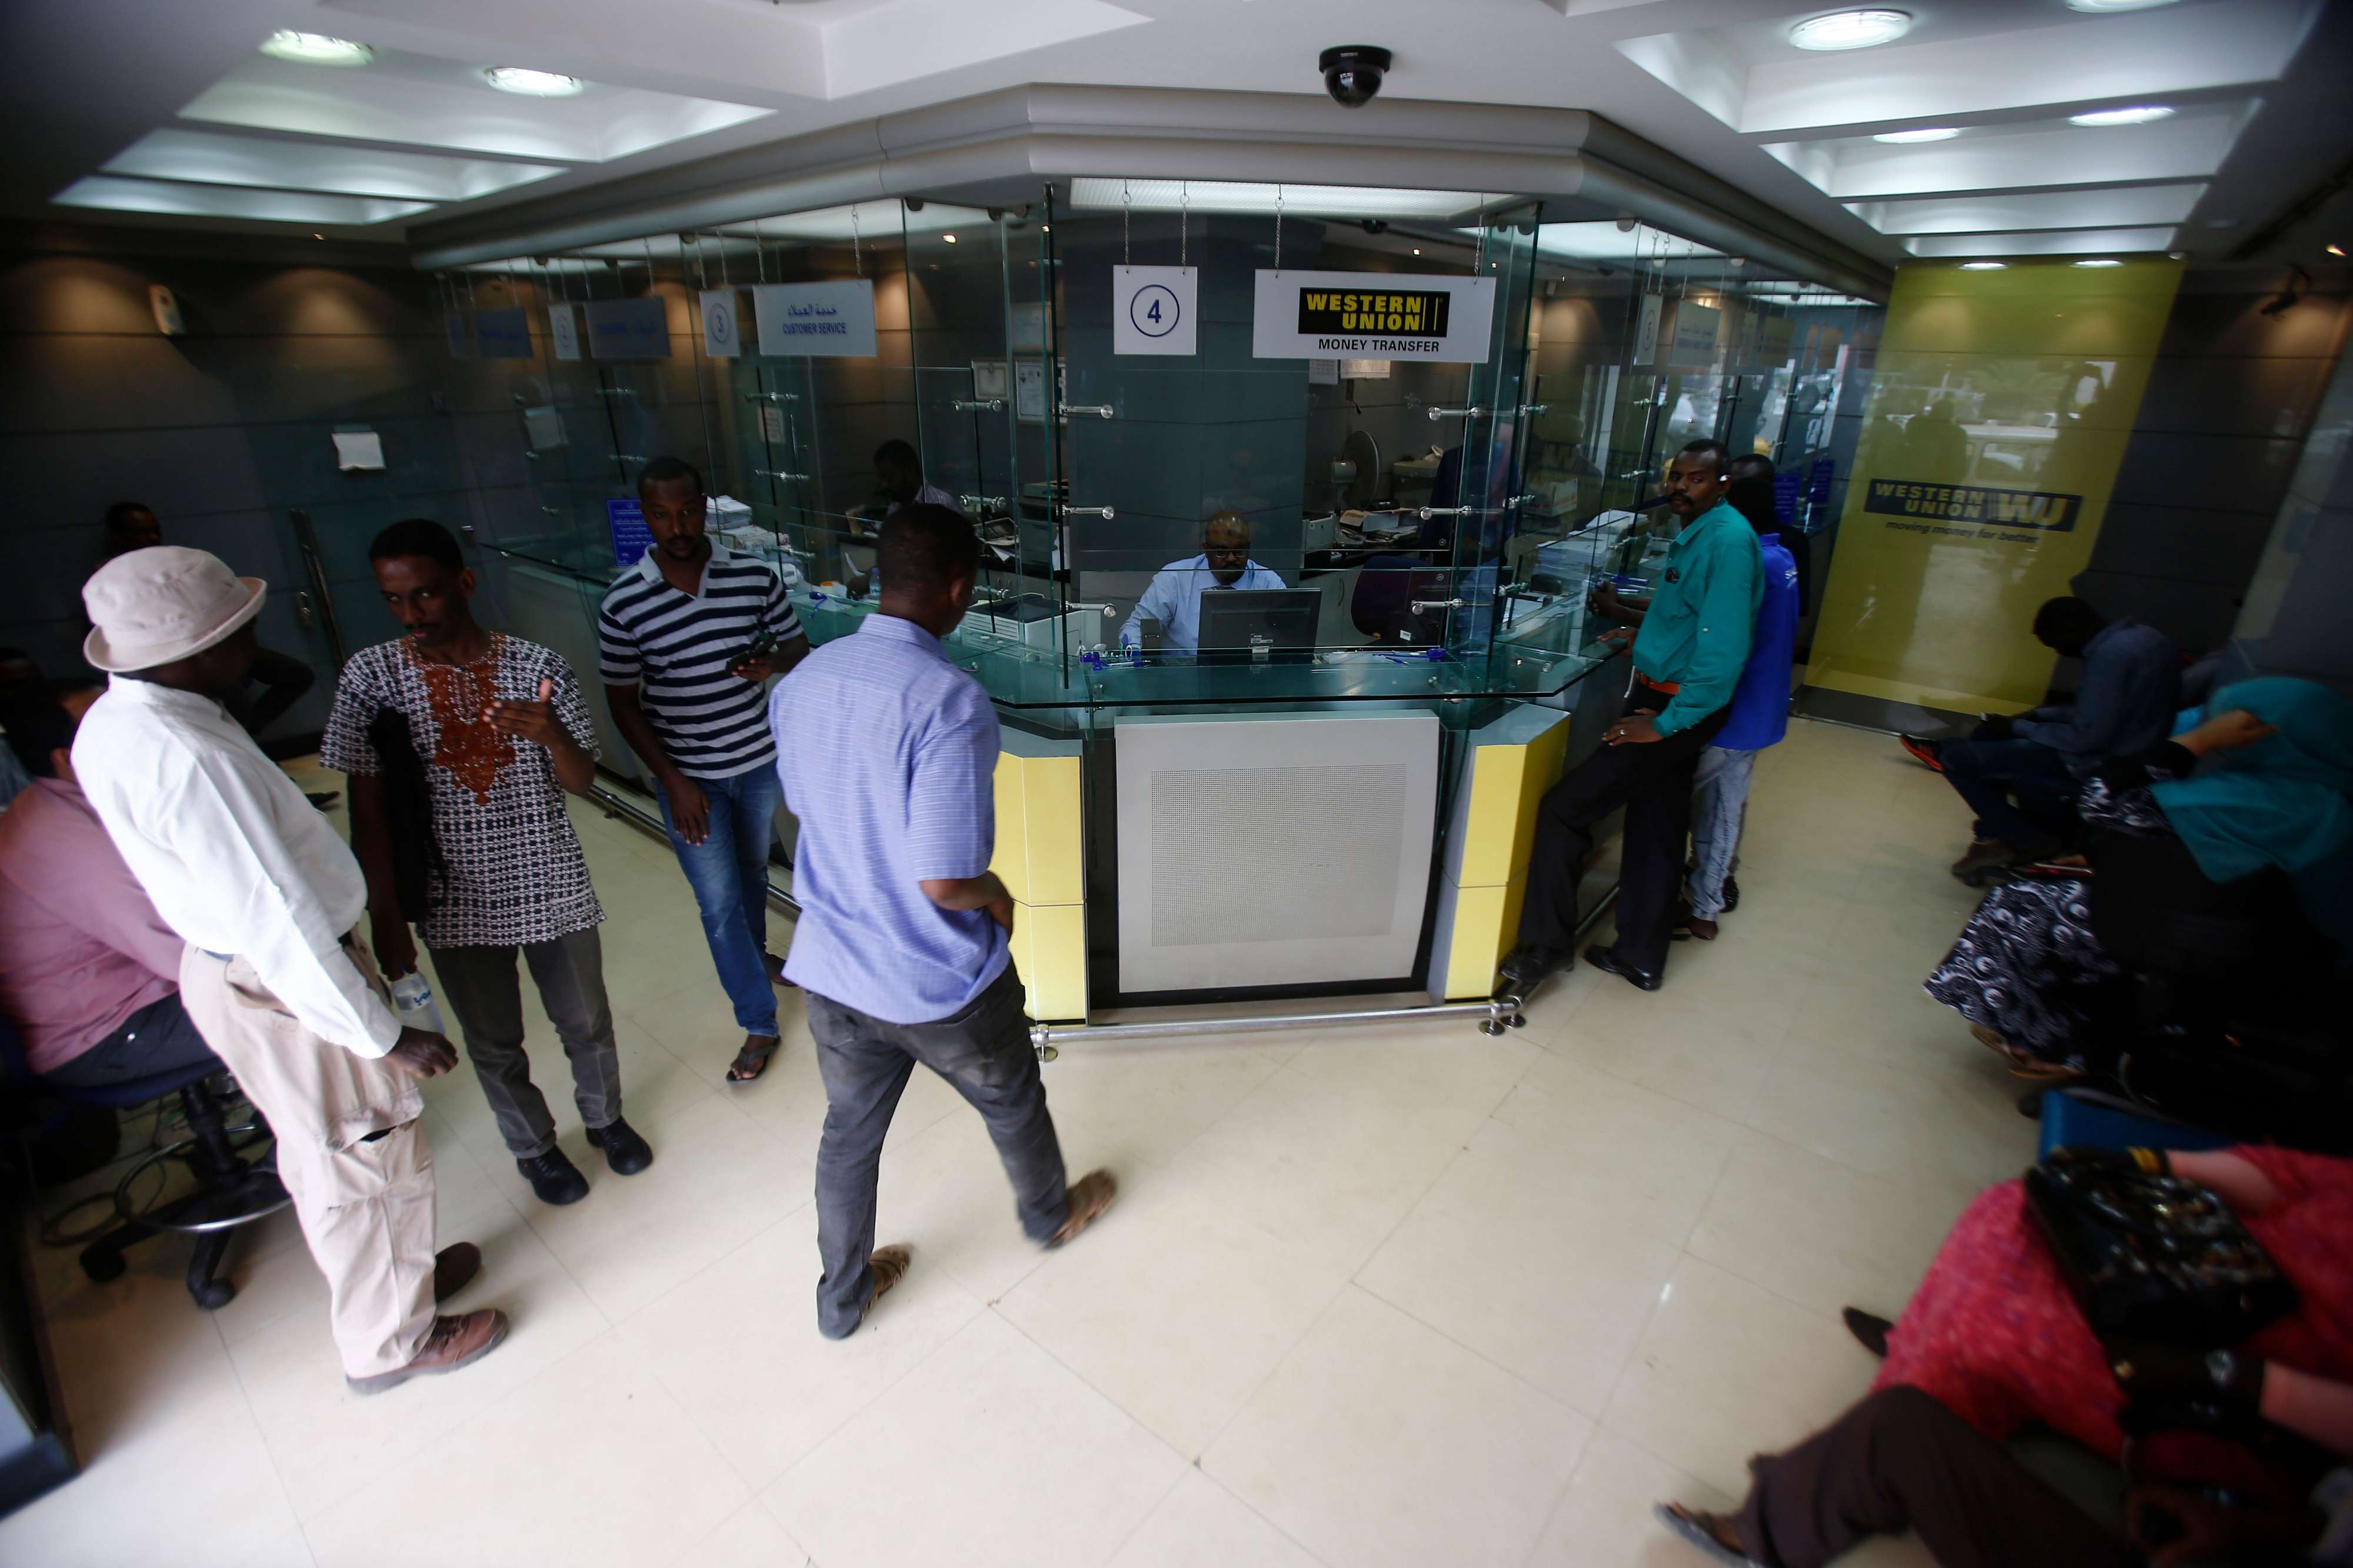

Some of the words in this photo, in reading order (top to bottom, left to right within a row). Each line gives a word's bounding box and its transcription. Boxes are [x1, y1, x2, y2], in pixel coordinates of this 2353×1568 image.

[787, 303, 814, 318] العملاء
[815, 303, 837, 316] خدمة
[1147, 299, 1161, 323] 4
[1307, 293, 1421, 312] WESTERN
[782, 322, 817, 334] CUSTOMER
[818, 322, 846, 334] SERVICE
[1342, 313, 1419, 331] UNION
[1318, 338, 1367, 350] MONEY
[1372, 339, 1439, 352] TRANSFER
[1875, 482, 1986, 505] WESTERN
[1904, 500, 1982, 518] UNION
[1886, 521, 1930, 534] moving
[1932, 526, 1976, 538] money
[1977, 529, 1997, 539] for
[1998, 531, 2041, 543] better
